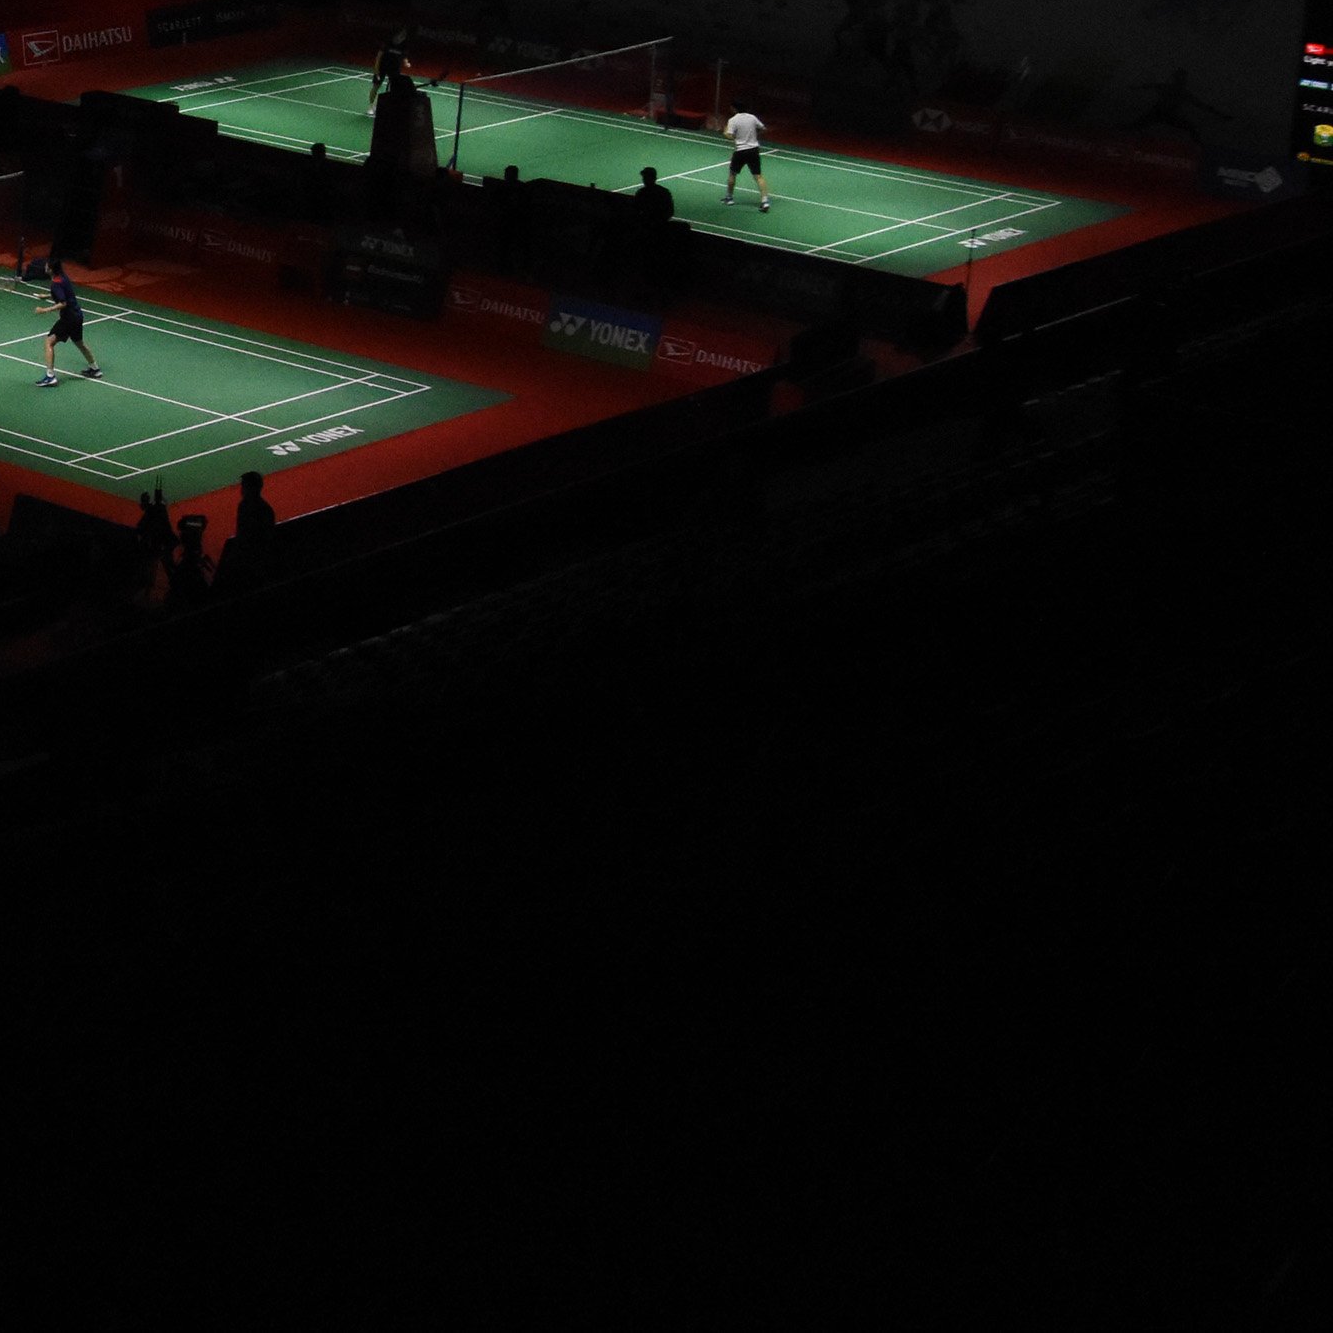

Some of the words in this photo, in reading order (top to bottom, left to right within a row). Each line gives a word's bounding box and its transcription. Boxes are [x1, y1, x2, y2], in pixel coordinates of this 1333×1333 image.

[62, 26, 132, 54] DAIHATSU
[480, 297, 546, 325] DAIHATSU
[588, 318, 651, 353] YONEX
